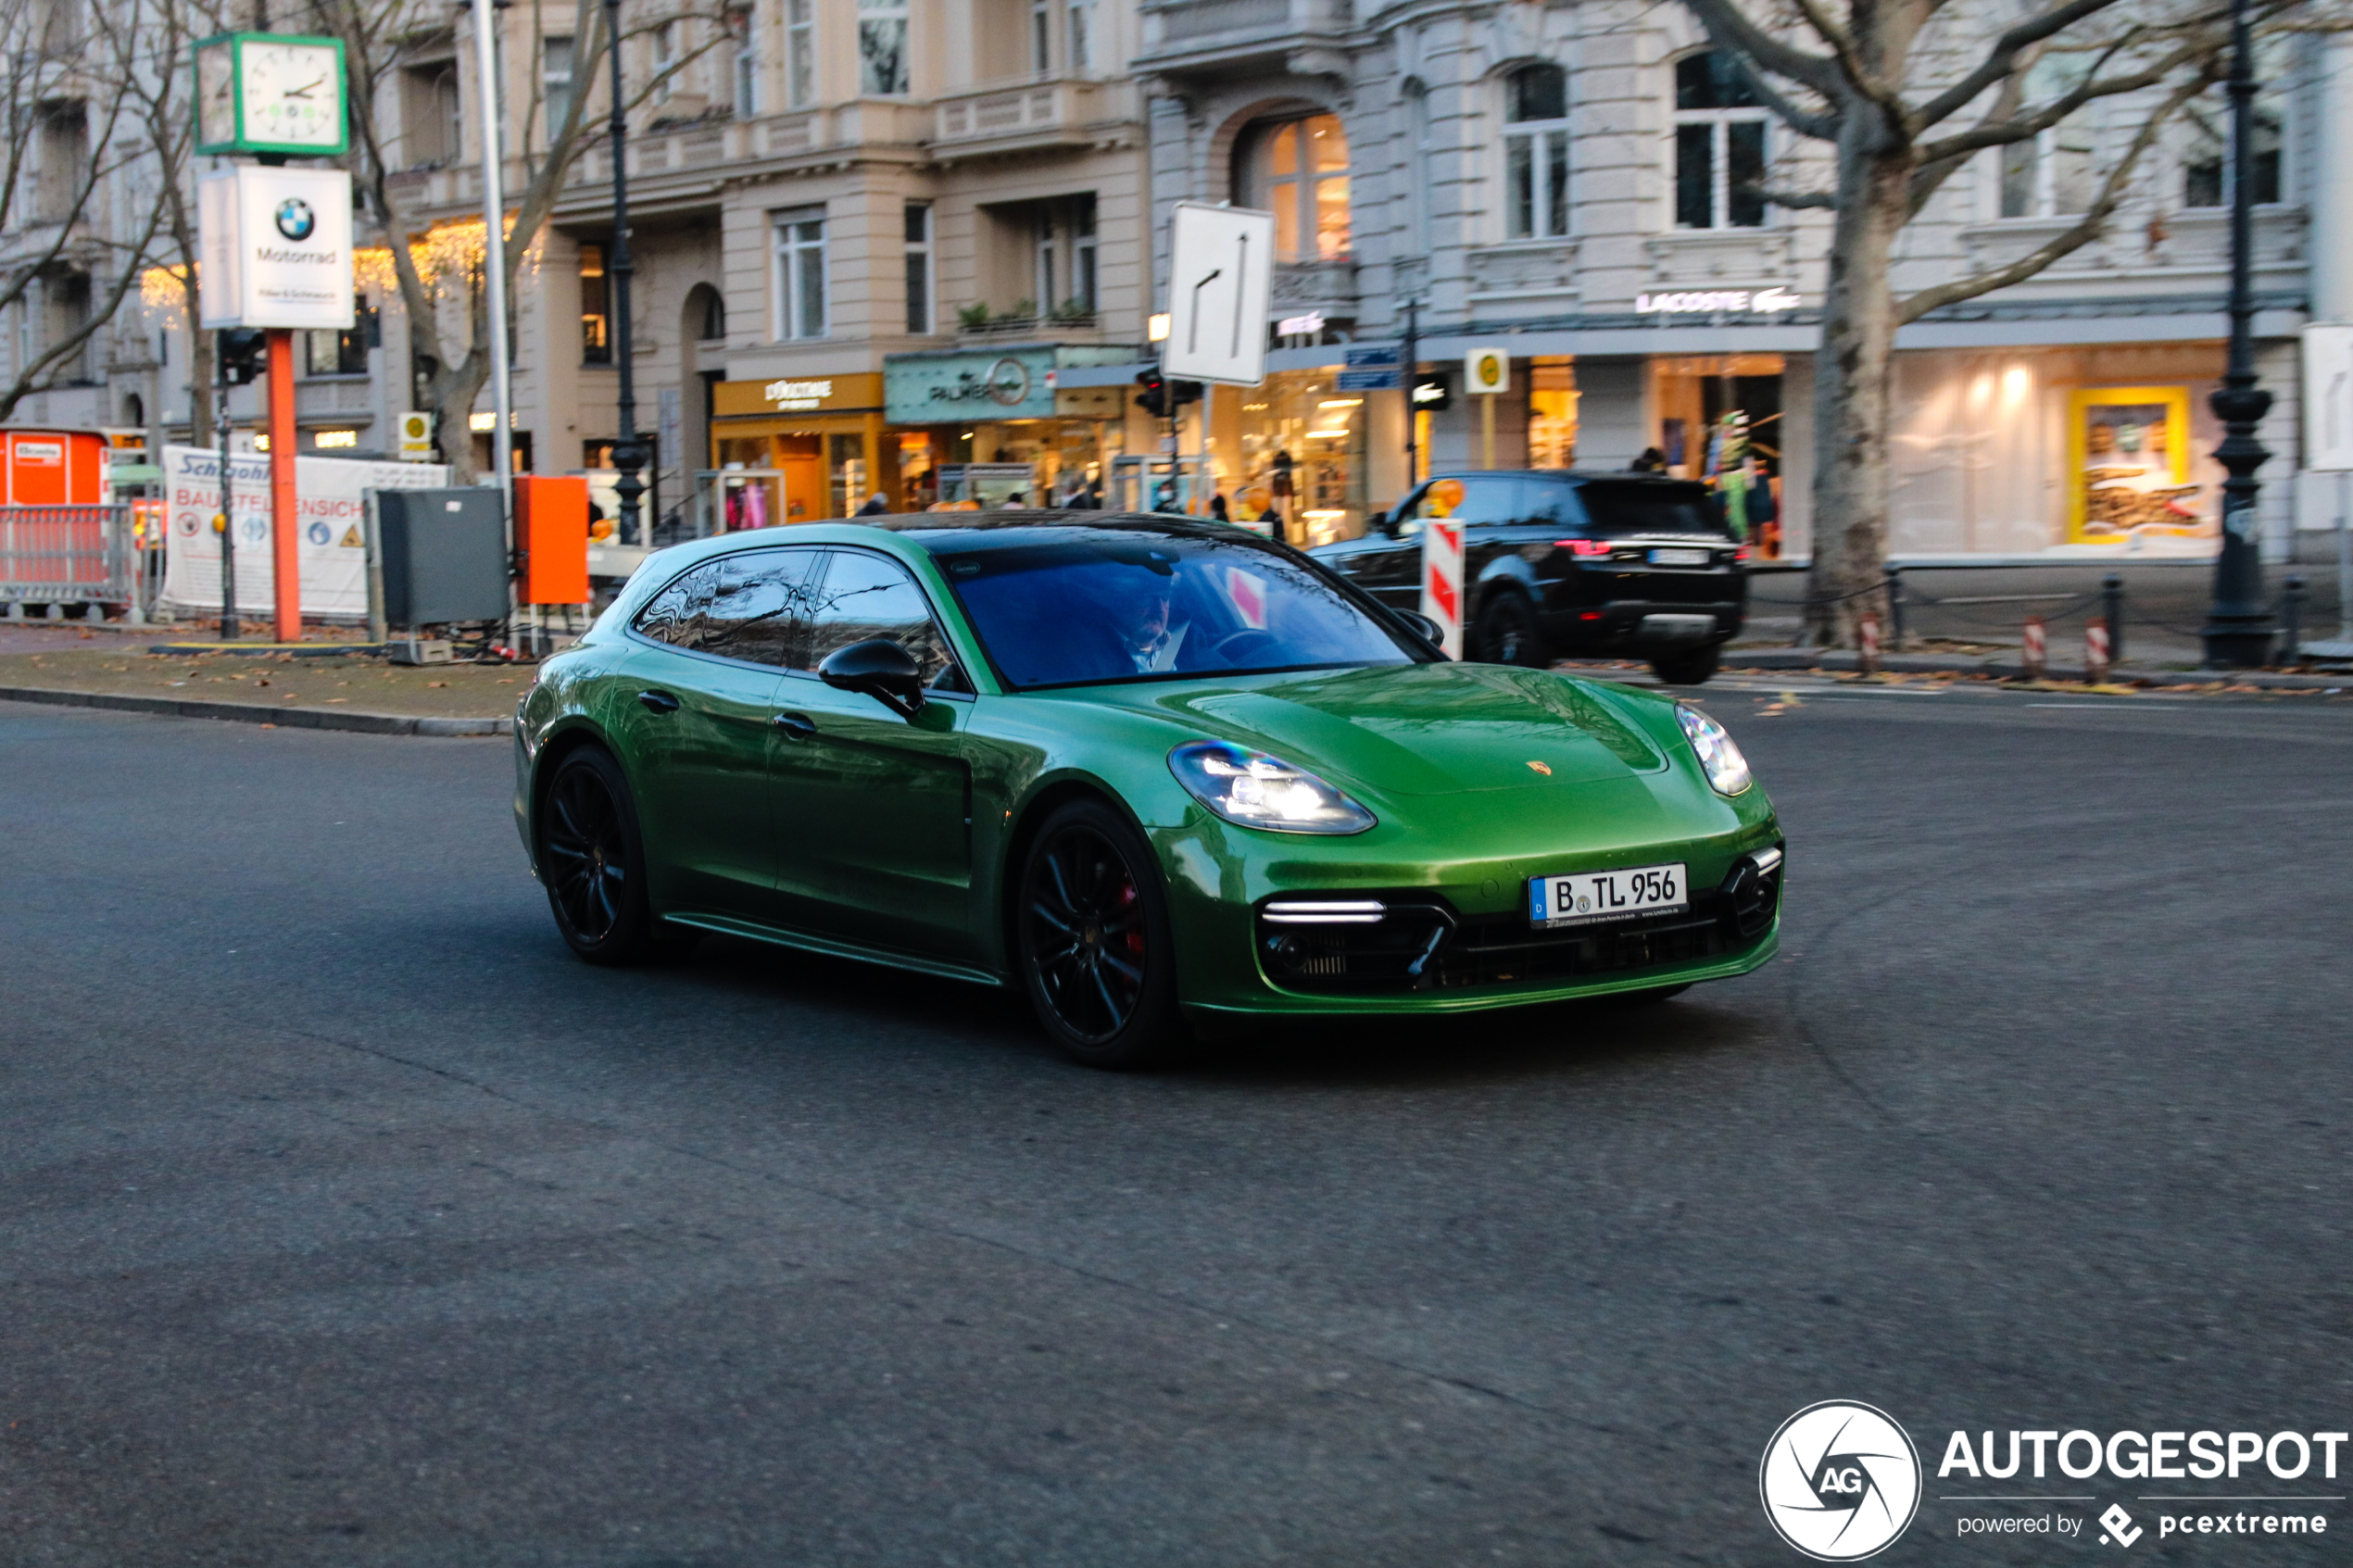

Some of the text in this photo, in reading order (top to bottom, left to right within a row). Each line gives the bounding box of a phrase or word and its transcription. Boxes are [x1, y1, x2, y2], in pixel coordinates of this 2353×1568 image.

[257, 246, 336, 265] Motorrad
[1635, 290, 1750, 313] LACOSTE
[1556, 871, 1676, 912] B TL 956
[1535, 905, 1542, 913] D
